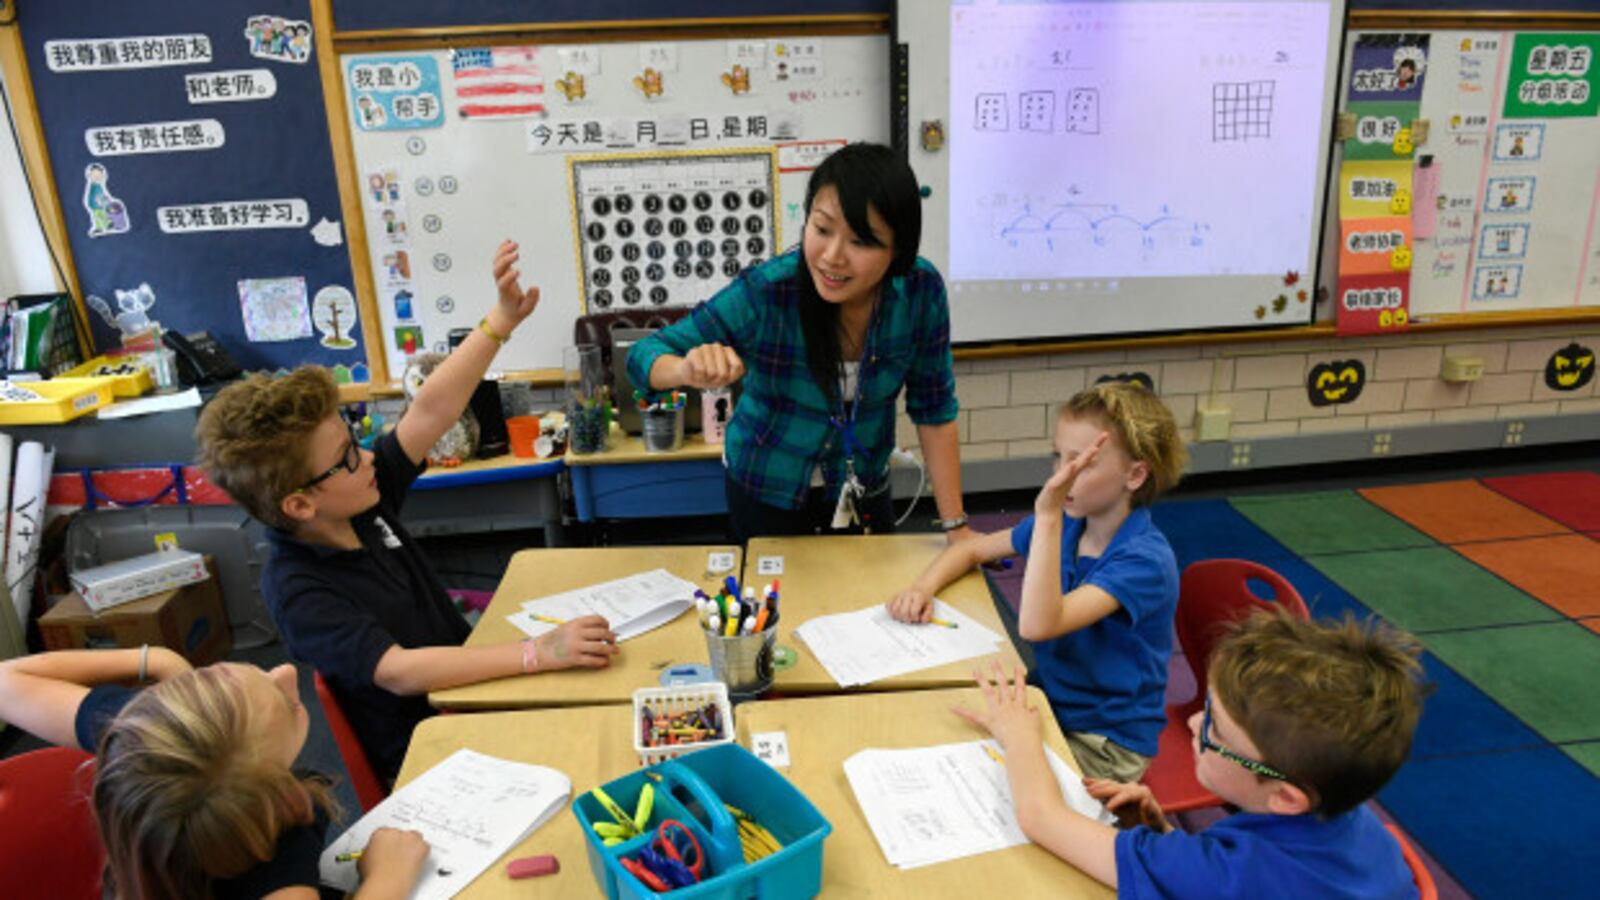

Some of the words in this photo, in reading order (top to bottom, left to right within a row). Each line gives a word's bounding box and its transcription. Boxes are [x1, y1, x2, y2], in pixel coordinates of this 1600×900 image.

[51, 38, 211, 66] 我尊重我的朋友
[1530, 49, 1587, 70] 星期五
[188, 75, 266, 98] 和老师。
[356, 68, 418, 88] 我是小
[395, 97, 435, 117] 帮手
[95, 124, 215, 152] 我有责任感。
[532, 122, 602, 145] 今天是
[1362, 120, 1397, 138] 很好
[1352, 180, 1396, 197] 要加油
